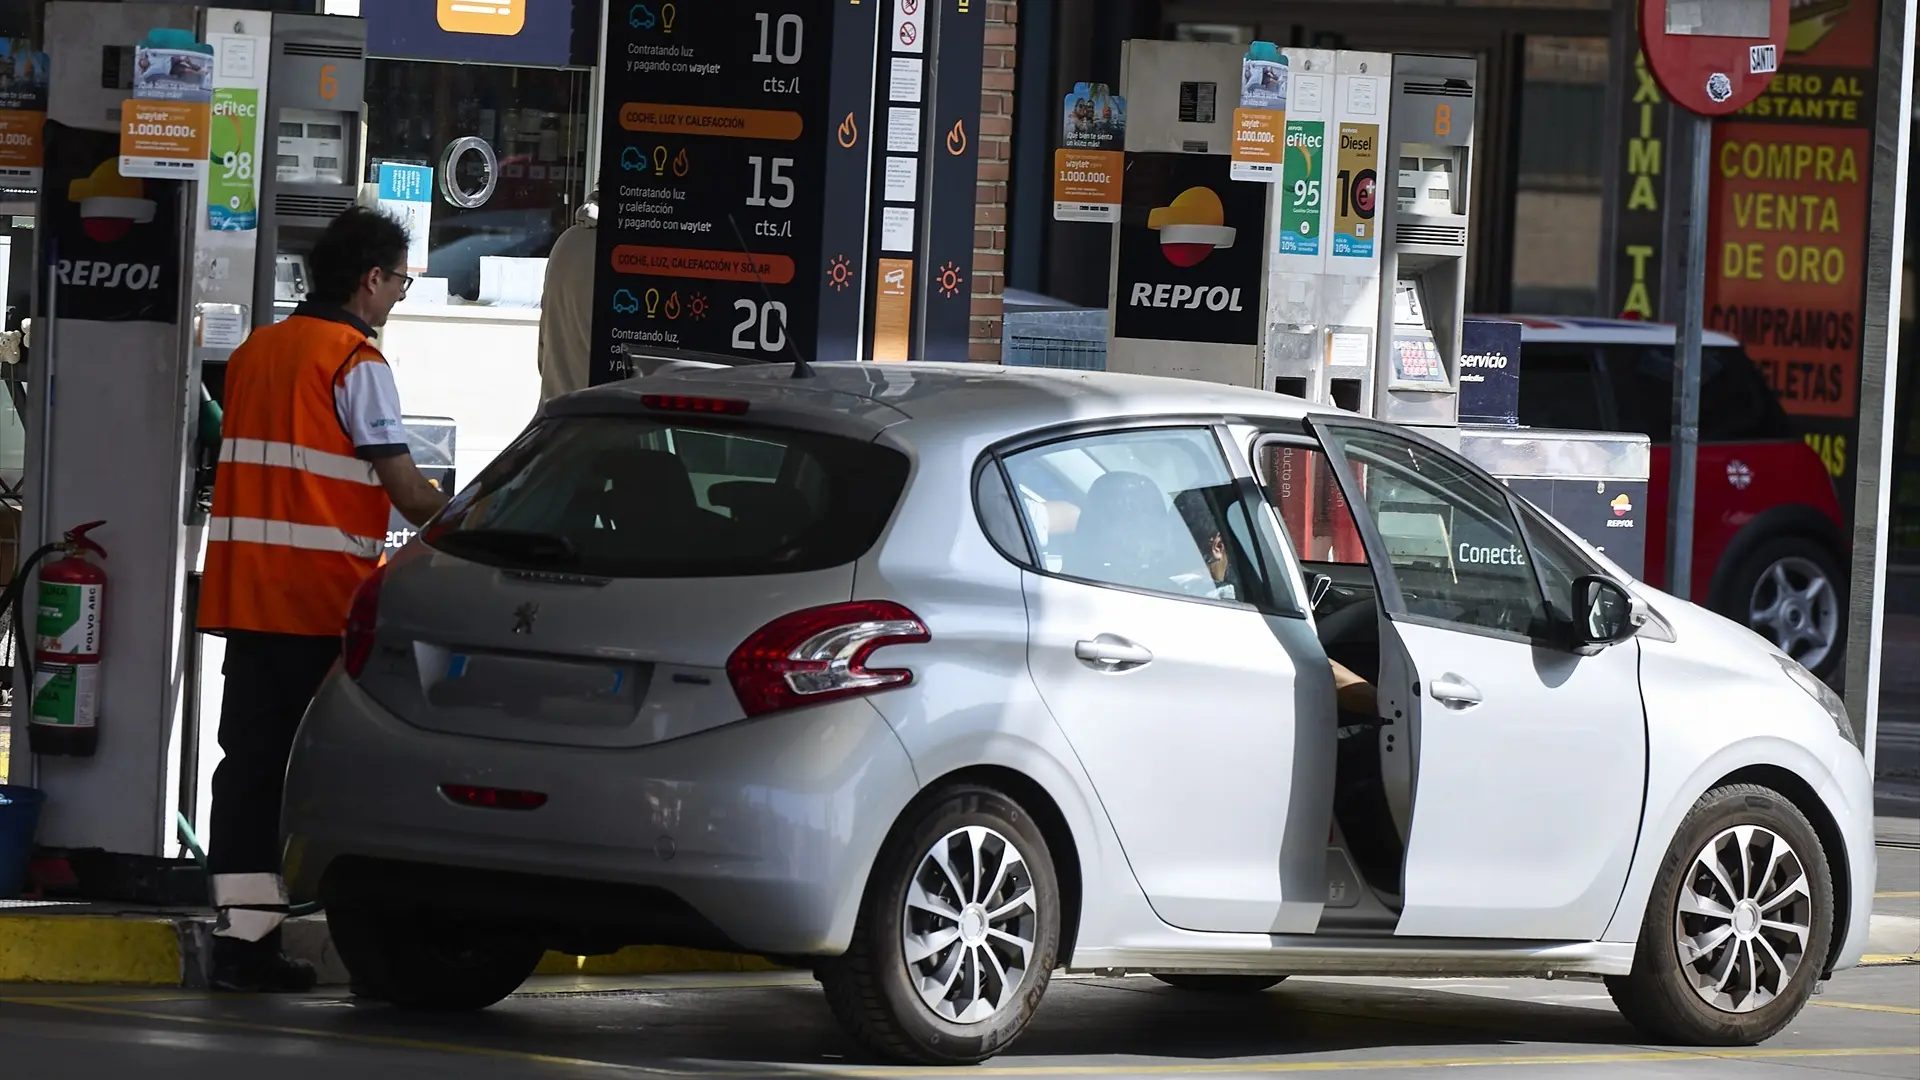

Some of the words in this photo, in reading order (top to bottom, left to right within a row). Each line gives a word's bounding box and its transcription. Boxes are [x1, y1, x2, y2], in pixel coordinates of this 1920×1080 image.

[752, 12, 803, 65] 10
[627, 43, 679, 56] Contratando
[681, 45, 694, 57] luz
[1752, 47, 1773, 70] SANTO
[626, 60, 633, 71] y
[633, 60, 670, 73] pagando
[672, 63, 687, 72] con
[319, 64, 337, 99] 6
[763, 77, 800, 94] cts./l
[1831, 77, 1864, 96] AL
[213, 100, 255, 117] efitec
[1627, 3, 1661, 210] XIMA
[1739, 97, 1857, 120] NSTANTE
[626, 111, 657, 125] COCHE,
[659, 113, 676, 125] LUZ
[677, 114, 684, 125] Y
[686, 115, 744, 129] CALEFACCIÓN
[1434, 103, 1451, 136] 8
[1286, 133, 1323, 147] efitec
[1341, 135, 1372, 150] Diesel
[223, 151, 252, 179] 98
[1720, 141, 1858, 183] COMPRA
[620, 185, 671, 199] Contratando
[673, 188, 685, 200] luz
[746, 156, 795, 208] 15
[1293, 180, 1320, 207] 95
[618, 203, 624, 214] y
[625, 202, 673, 214] calefacción
[1733, 193, 1840, 233] VENTA
[618, 218, 624, 228] y
[625, 218, 661, 230] pagando
[663, 221, 678, 230] con
[755, 220, 792, 237] cts./l
[619, 254, 649, 267] COCHE,
[672, 257, 731, 272] CALEFACCIÓN
[733, 261, 740, 273] Y
[741, 262, 770, 275] SOLAR
[1724, 242, 1765, 279] DE
[1776, 245, 1844, 284] ORO
[57, 260, 160, 291] REPSOL
[1129, 282, 1243, 312] REPSOL
[612, 328, 663, 341] Contratando
[665, 331, 679, 343] luz,
[732, 298, 787, 352] 20
[1711, 304, 1854, 349] COMPRAMOS
[1460, 352, 1507, 369] servicio
[1281, 484, 1291, 498] en
[88, 588, 96, 610] ABC
[86, 613, 95, 651] POLVO
